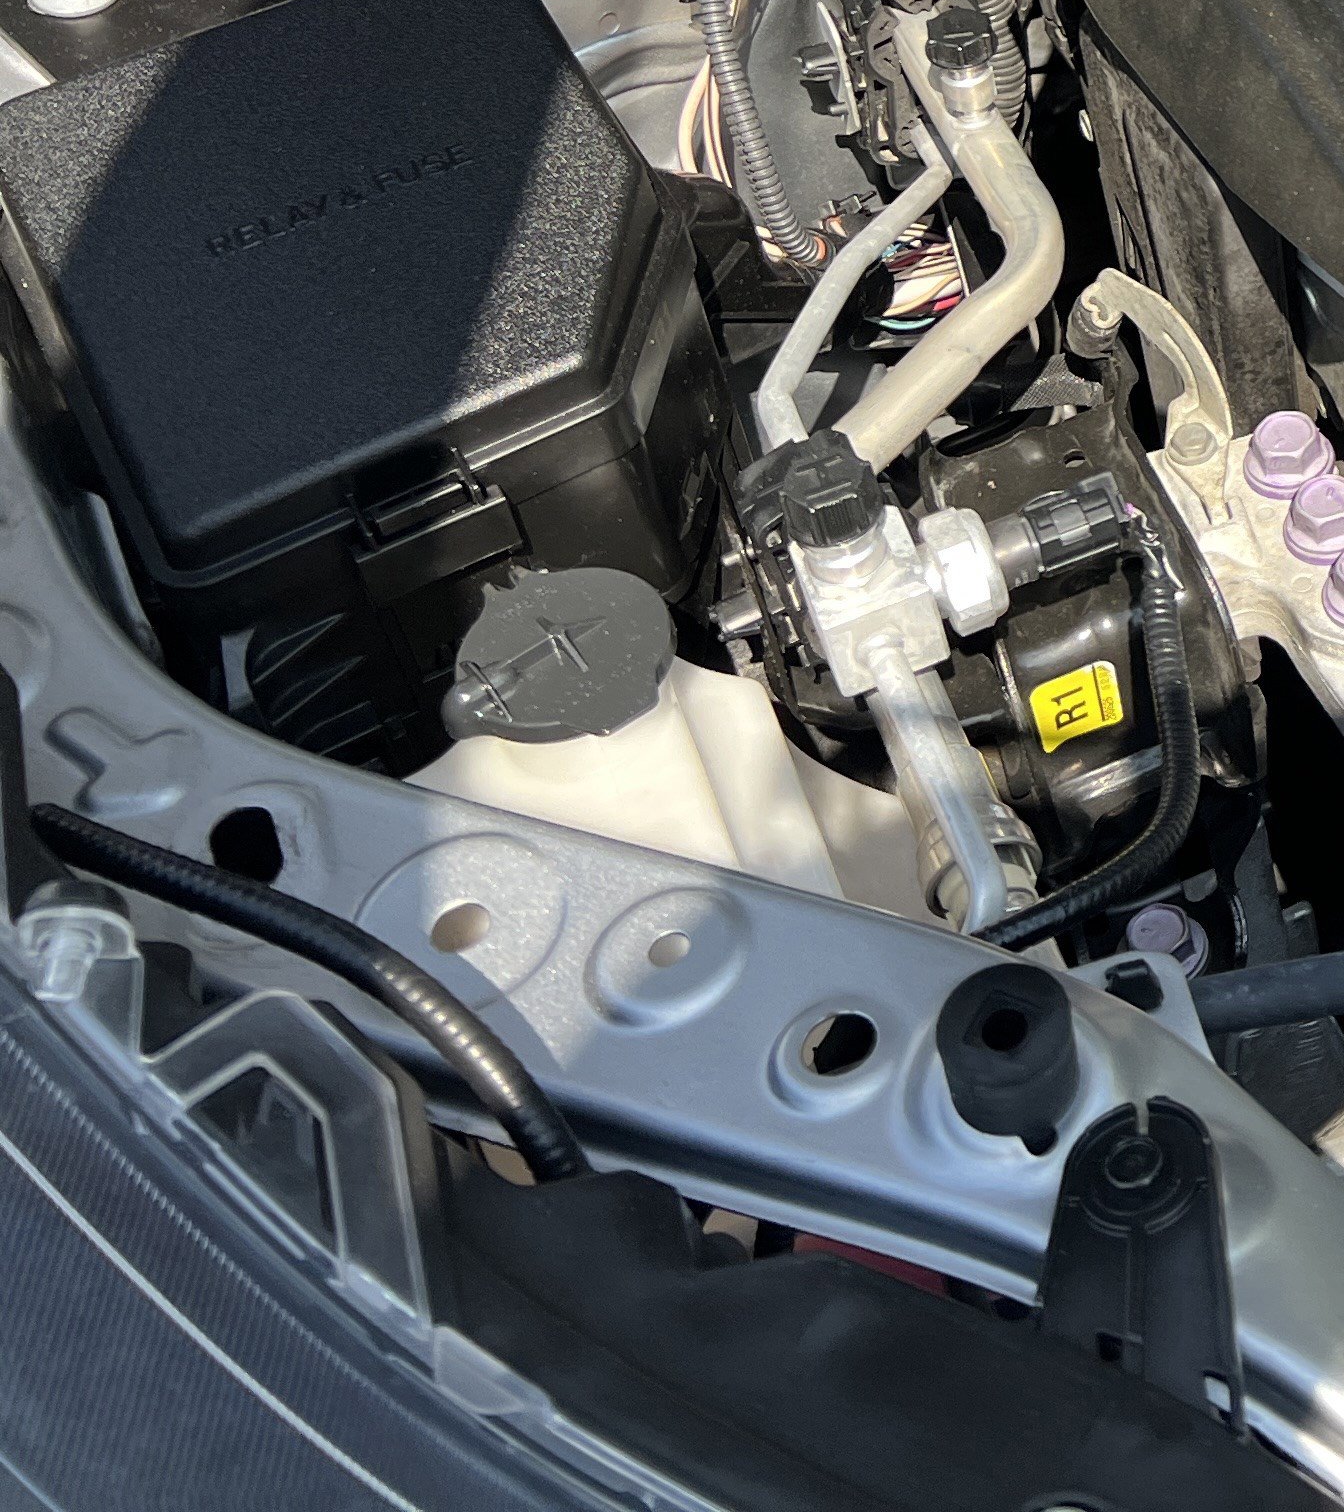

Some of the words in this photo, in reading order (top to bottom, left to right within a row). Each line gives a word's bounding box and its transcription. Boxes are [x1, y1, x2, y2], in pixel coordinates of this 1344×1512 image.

[205, 194, 329, 258] RELAY
[371, 142, 475, 192] FUSE
[1051, 685, 1089, 731] R1
